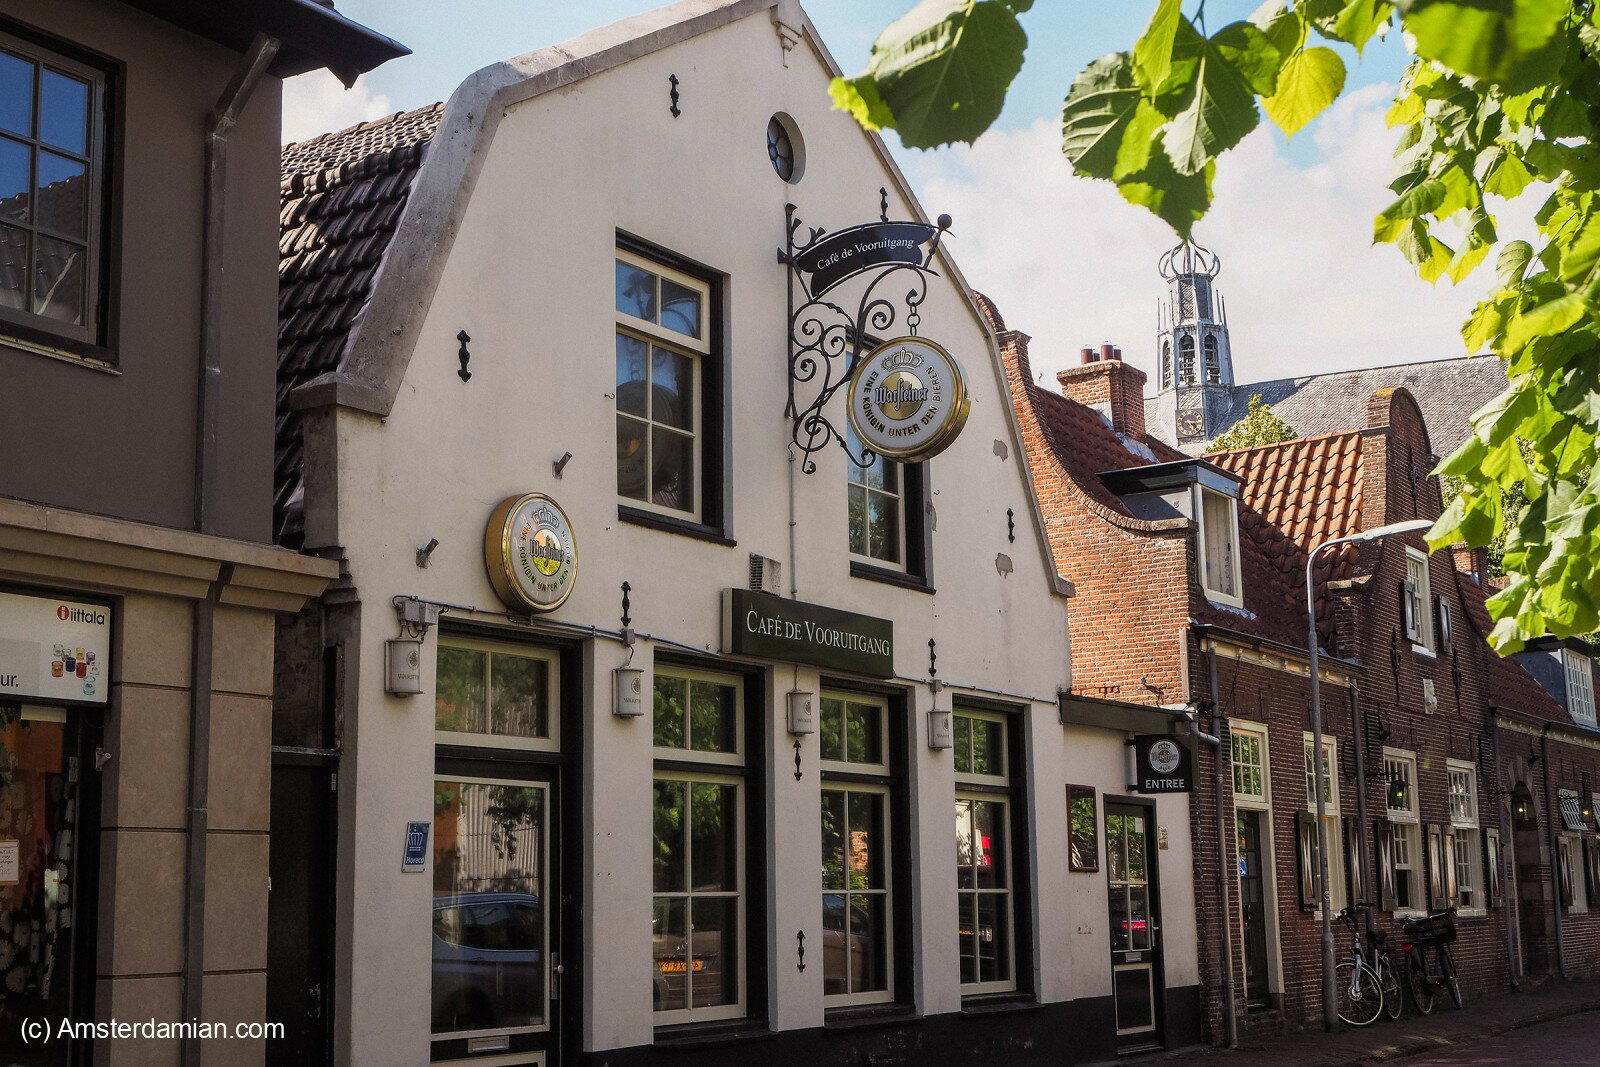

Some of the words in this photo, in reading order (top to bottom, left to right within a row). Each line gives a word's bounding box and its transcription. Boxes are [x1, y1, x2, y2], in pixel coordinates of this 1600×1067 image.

[817, 253, 839, 270] Café
[841, 248, 853, 260] de
[854, 238, 914, 254] Vooruitgang
[863, 370, 879, 394] EINE
[925, 366, 941, 402] BIEREN
[862, 396, 886, 434] KÖNIGIN
[920, 406, 938, 425] DEN
[888, 424, 921, 437] UNTER
[537, 581, 558, 592] UNTER
[558, 568, 569, 586] DEN
[70, 608, 104, 625] iittala
[785, 621, 802, 640] DE
[804, 620, 890, 656] VOORUITGANG
[1145, 778, 1184, 788] ENTREE
